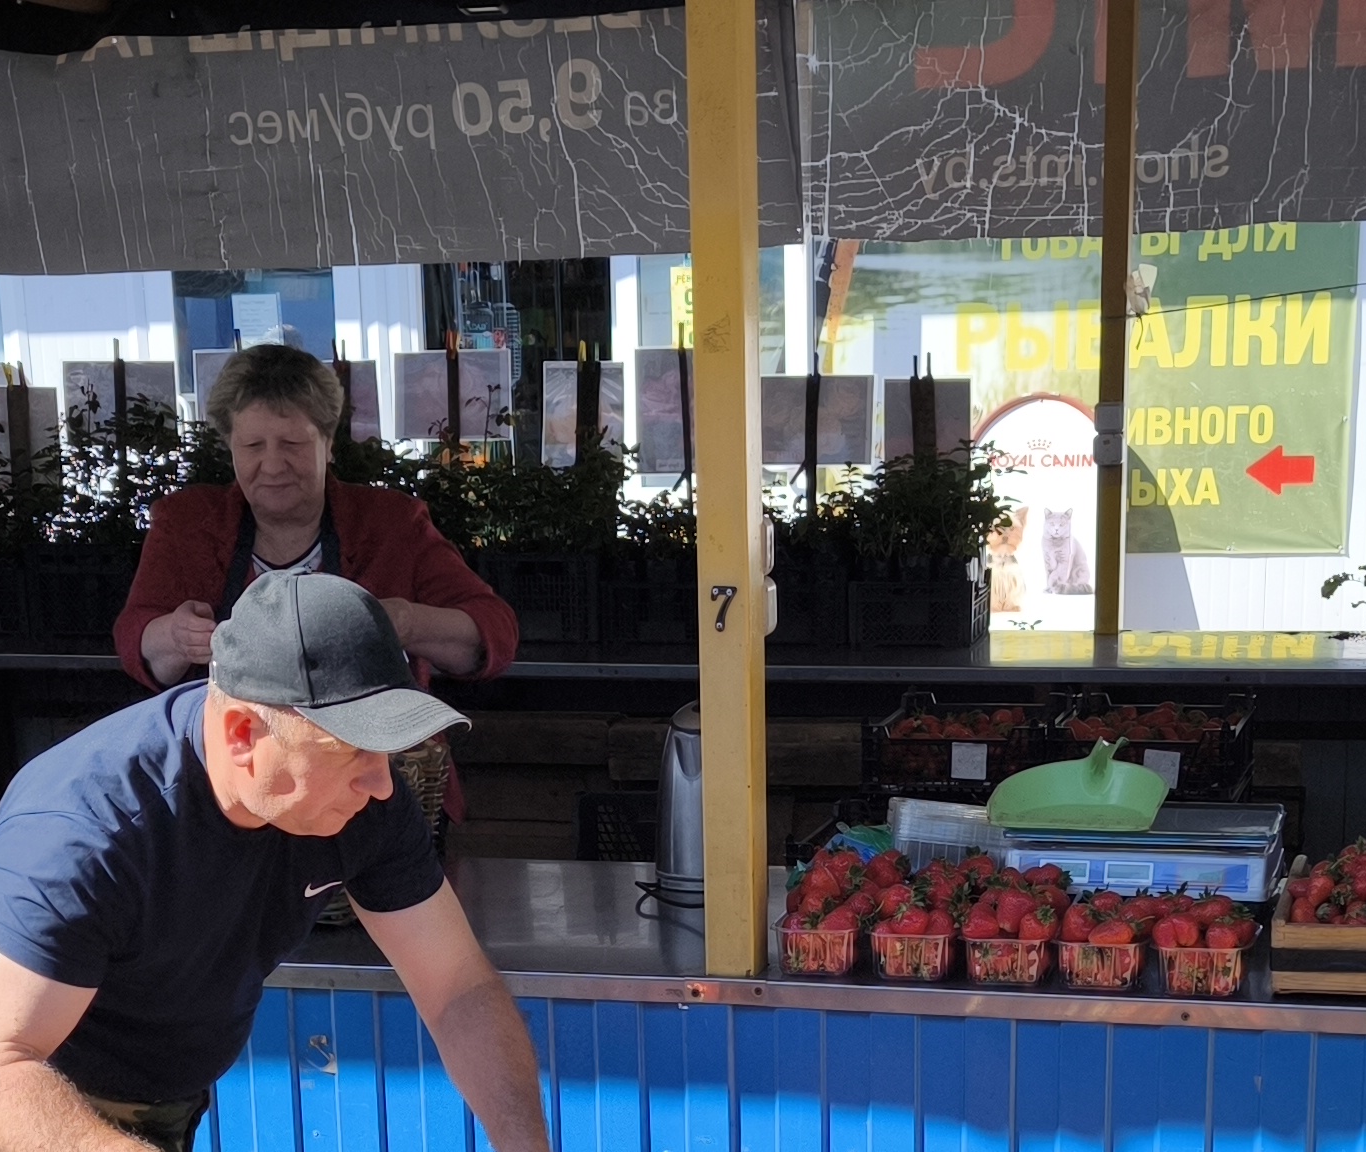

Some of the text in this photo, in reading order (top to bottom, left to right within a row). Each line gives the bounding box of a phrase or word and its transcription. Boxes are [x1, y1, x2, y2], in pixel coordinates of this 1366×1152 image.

[1000, 222, 1297, 262] ТОВАЫ ДЛЯ
[1044, 454, 1095, 467] CANIN
[1128, 468, 1221, 508] ЫХА
[710, 585, 737, 632] 7
